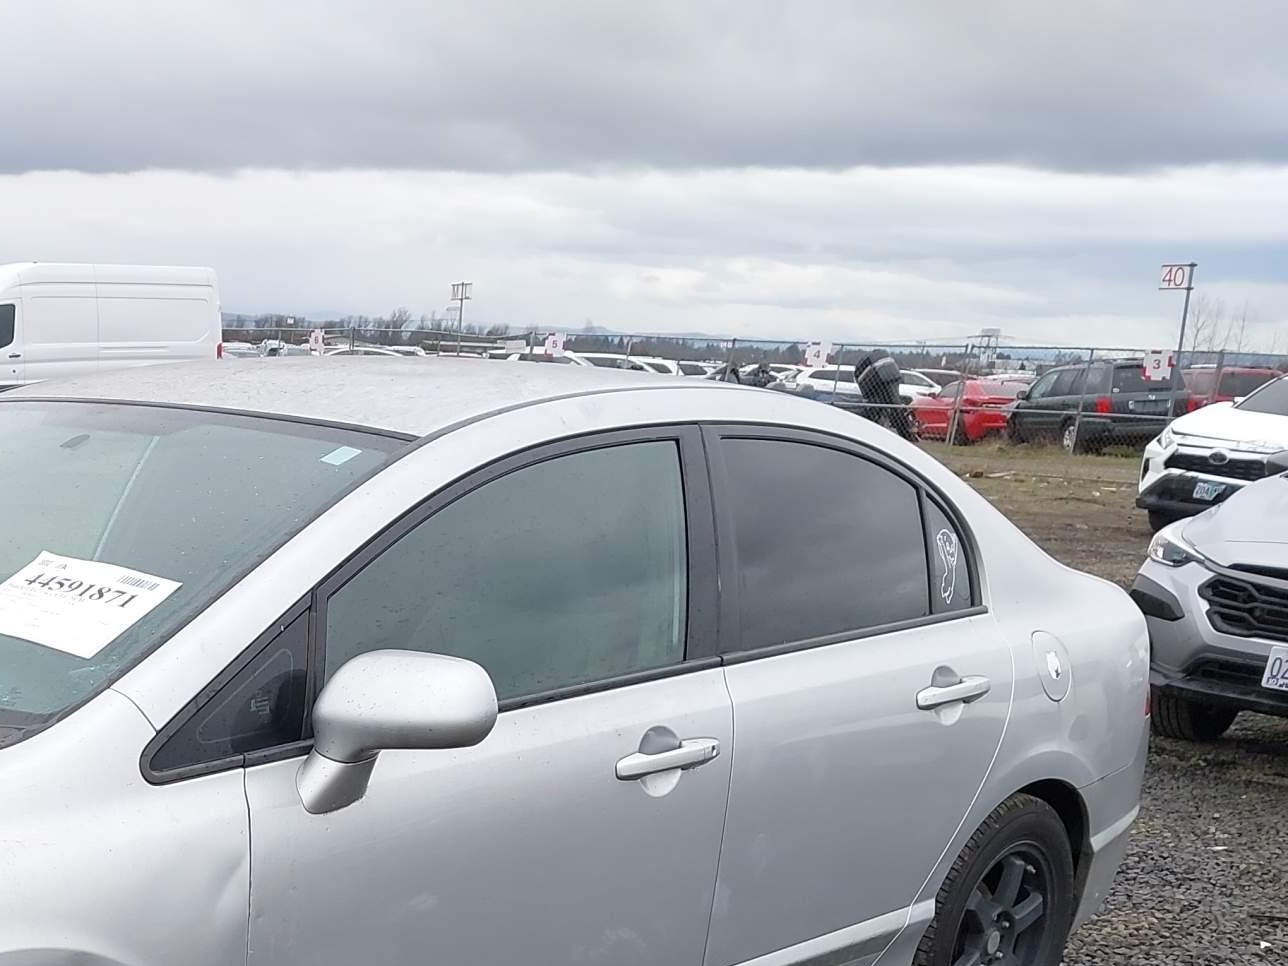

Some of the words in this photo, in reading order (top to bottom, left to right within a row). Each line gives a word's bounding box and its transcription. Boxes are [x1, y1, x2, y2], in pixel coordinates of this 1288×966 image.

[1162, 267, 1185, 287] 40
[551, 340, 558, 348] 5
[813, 350, 821, 359] 4
[1152, 359, 1161, 370] 3
[23, 572, 140, 609] 44591871
